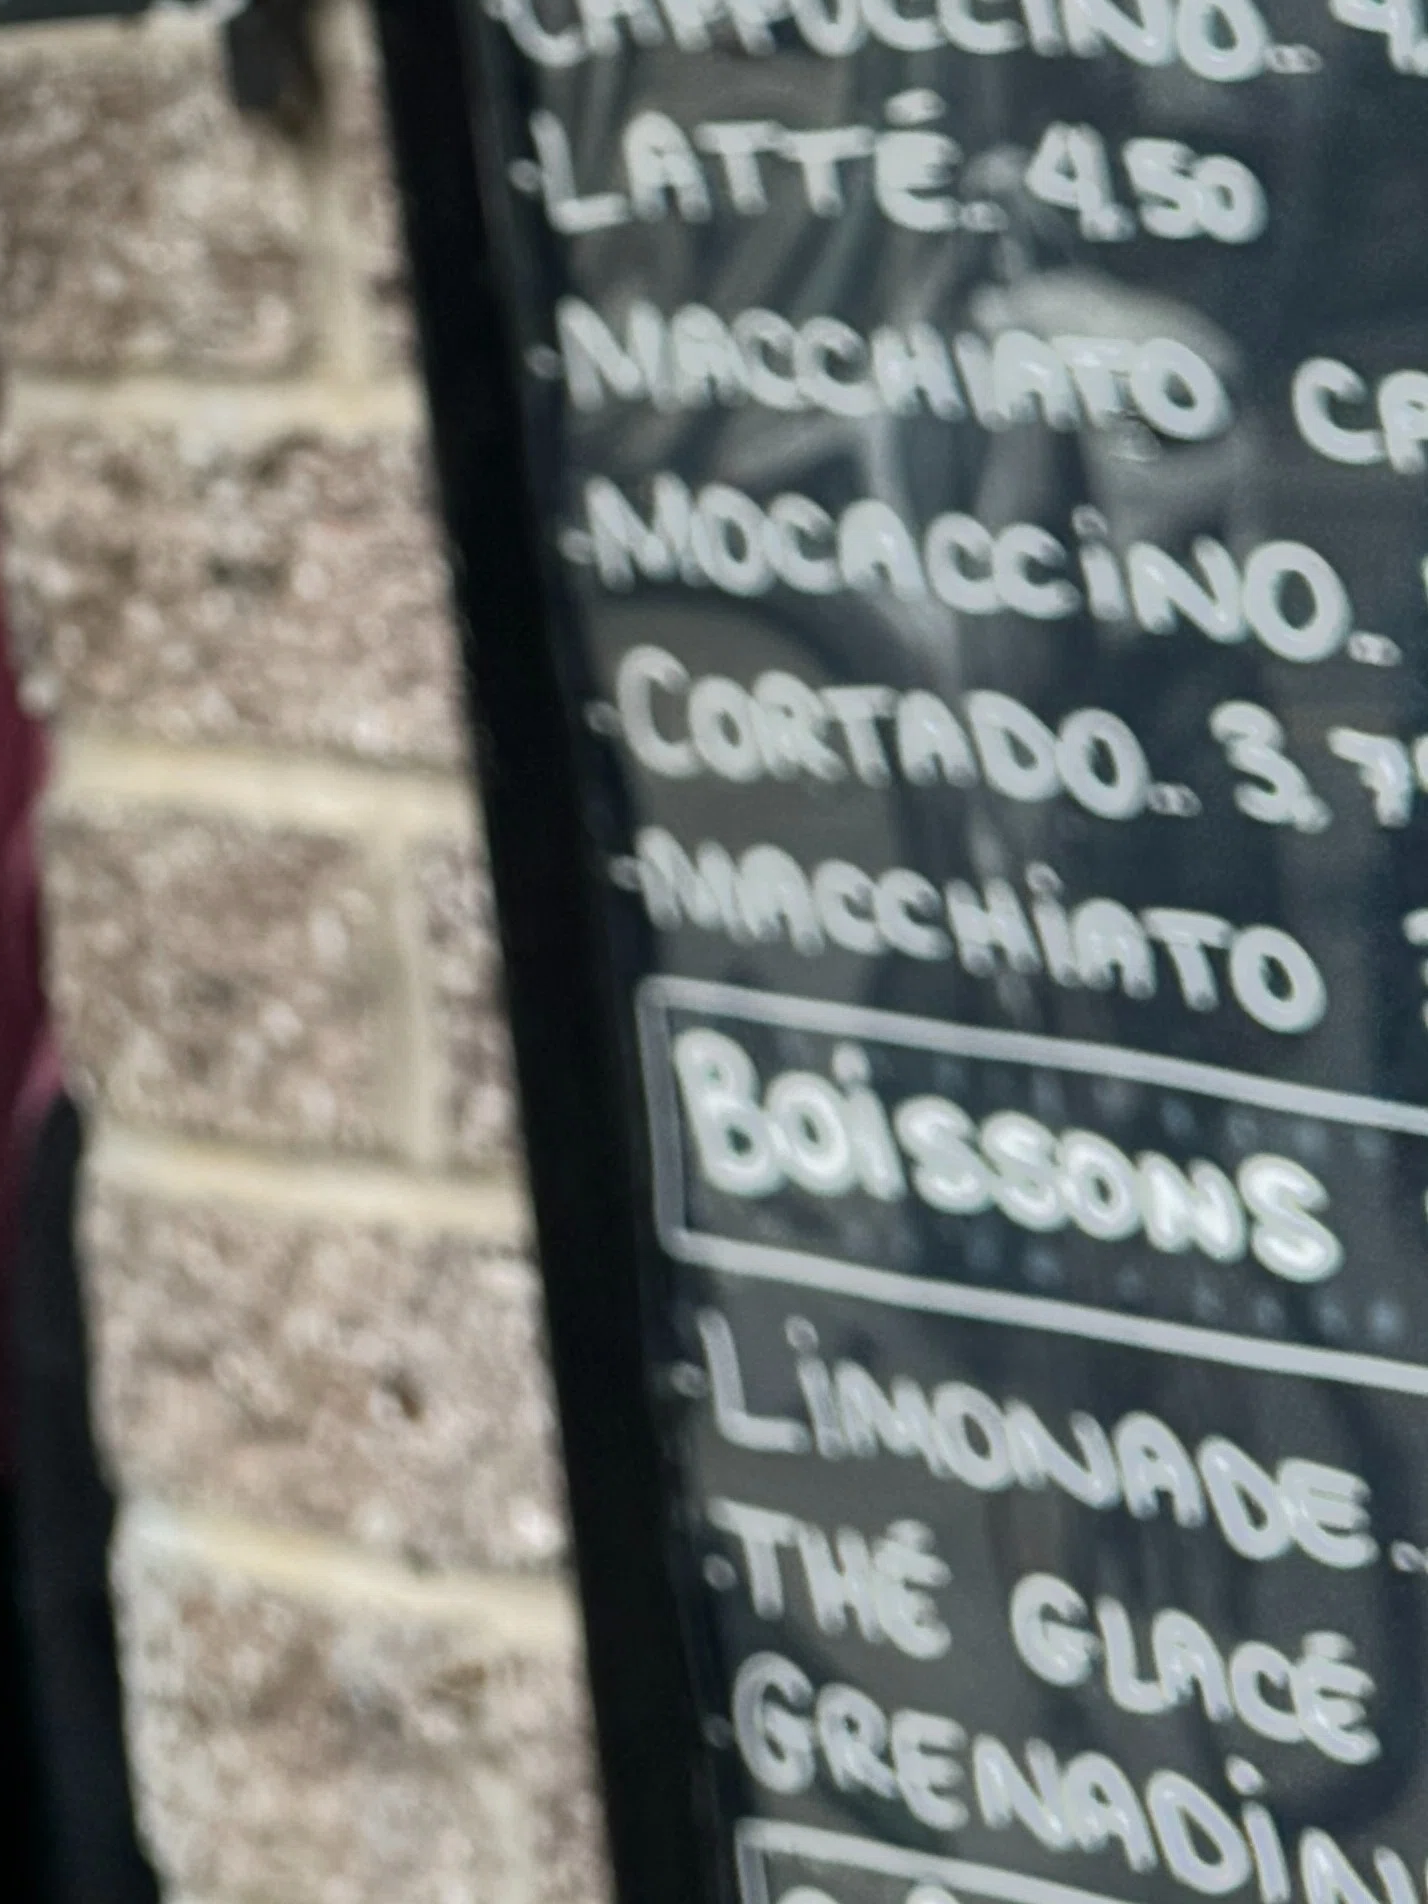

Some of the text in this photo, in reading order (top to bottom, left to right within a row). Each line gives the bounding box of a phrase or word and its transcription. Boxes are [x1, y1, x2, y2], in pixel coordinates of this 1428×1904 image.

[1025, 121, 1266, 244] 4.50
[1208, 699, 1428, 835] 3.7
[706, 1495, 1382, 1765] THÉ GLACÉ
[732, 1650, 1428, 1904] GRENADiN
